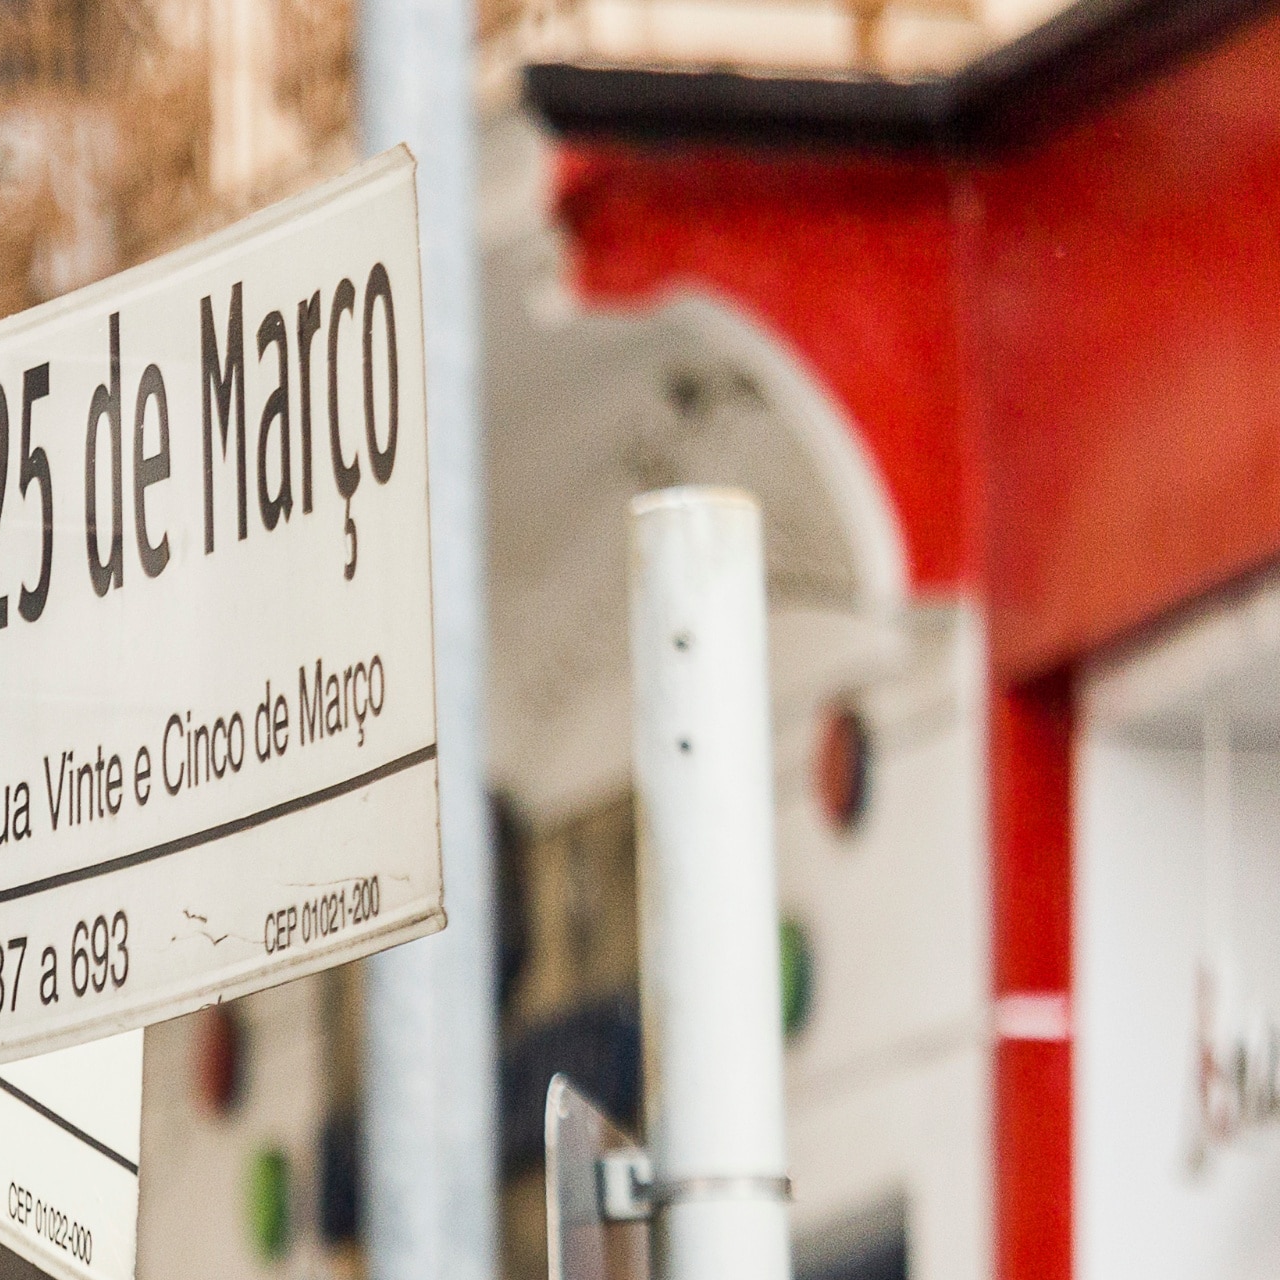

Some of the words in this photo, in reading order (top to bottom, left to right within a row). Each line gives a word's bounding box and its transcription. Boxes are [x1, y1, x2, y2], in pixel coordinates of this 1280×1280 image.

[84, 311, 171, 598] de
[200, 262, 399, 581] Março
[44, 745, 123, 831] Vinte
[134, 745, 152, 806] e
[162, 709, 245, 796] Cinco
[254, 678, 289, 763] de
[298, 653, 386, 748] Março
[39, 945, 59, 1005] a
[71, 909, 130, 997] 693
[264, 910, 299, 955] CEP
[301, 874, 381, 944] 01021-200
[7, 1181, 33, 1226] CEP
[34, 1199, 93, 1265] 01022-000
